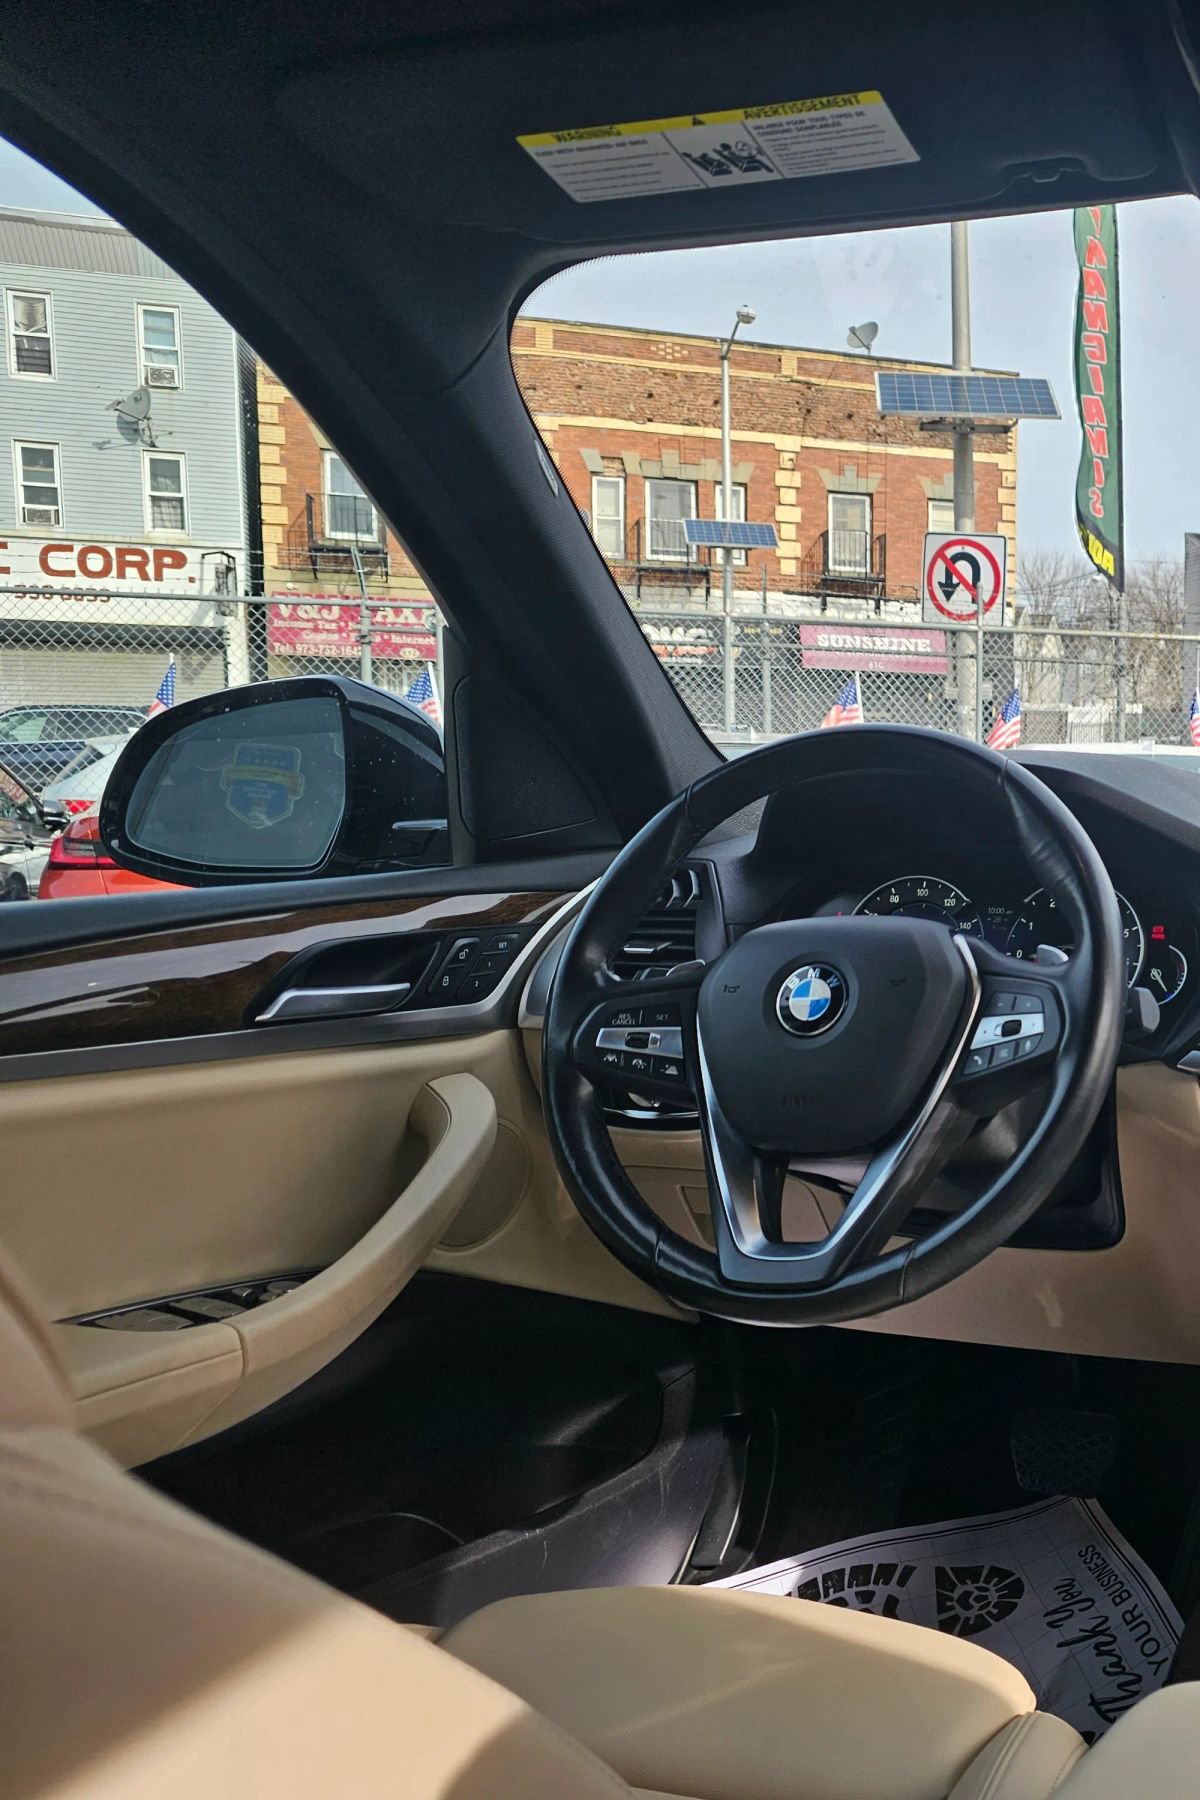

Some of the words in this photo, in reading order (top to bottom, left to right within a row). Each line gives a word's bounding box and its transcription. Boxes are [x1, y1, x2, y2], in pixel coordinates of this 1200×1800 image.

[39, 544, 196, 583] CORP.
[817, 634, 931, 652] SUNSHINE
[917, 888, 929, 897] 100
[889, 894, 899, 903] 80
[944, 898, 956, 907] 120
[959, 921, 972, 930] 140
[498, 941, 508, 949] SET
[1016, 949, 1023, 959] 0
[787, 967, 840, 989] BMW
[1077, 1544, 1133, 1608] BUSINESS
[1121, 1602, 1169, 1677] YOUR
